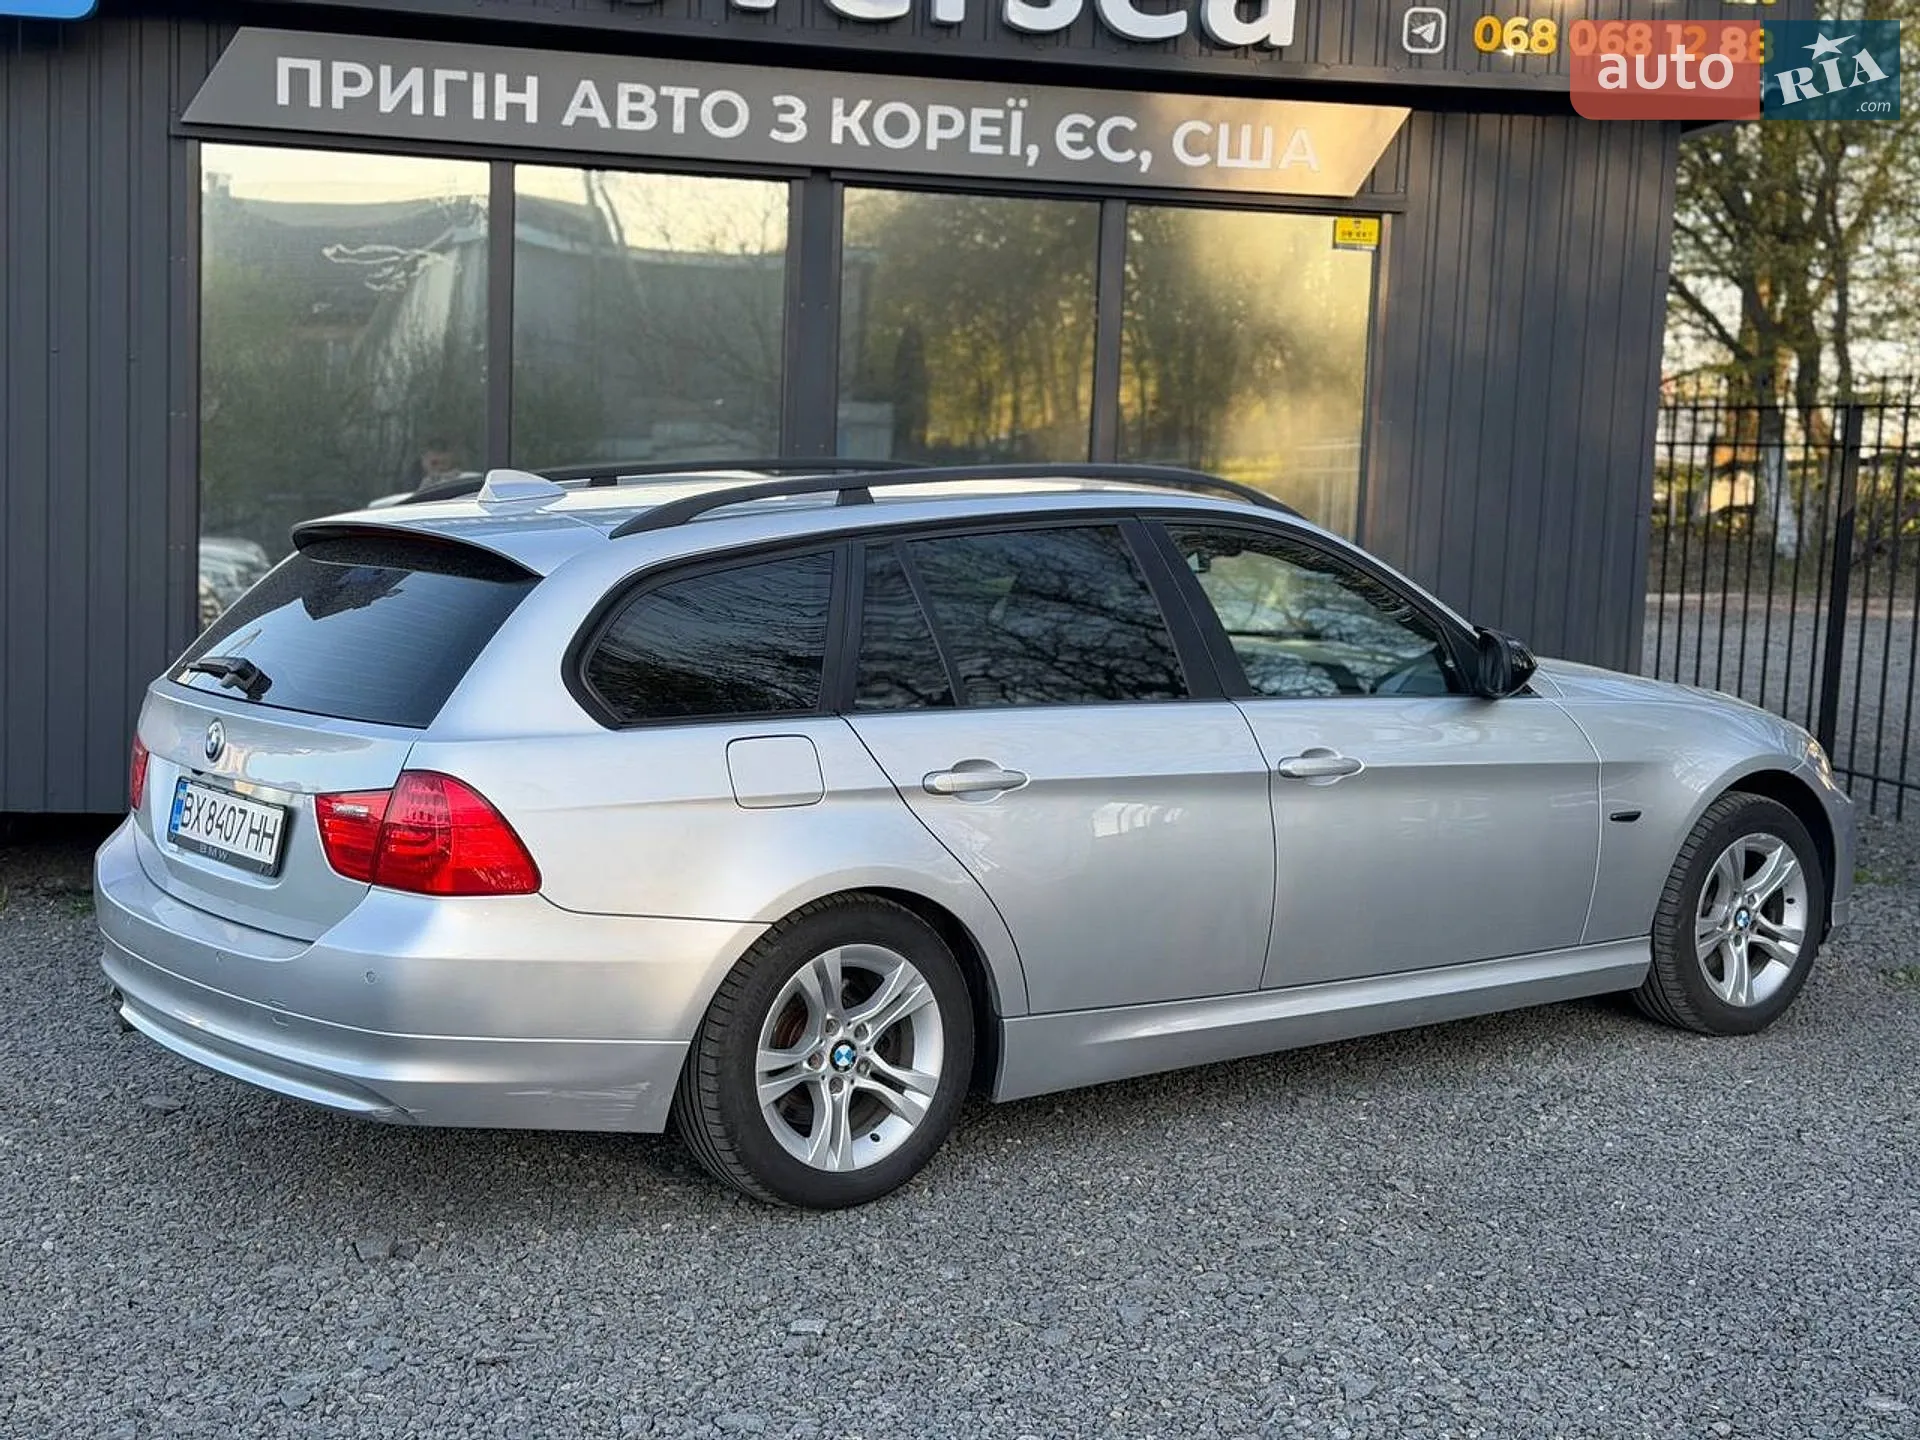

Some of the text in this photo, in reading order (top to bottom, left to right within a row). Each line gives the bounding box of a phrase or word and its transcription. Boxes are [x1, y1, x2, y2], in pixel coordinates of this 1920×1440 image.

[1473, 16, 1557, 55] 068
[1569, 20, 1653, 57] 068
[276, 57, 539, 123] ПРИГІН
[561, 79, 751, 139] АВТО
[830, 98, 1040, 167] КОРЕЇ,
[1055, 115, 1153, 172] ЄС,
[1172, 119, 1321, 172] США
[205, 800, 247, 844] 8407
